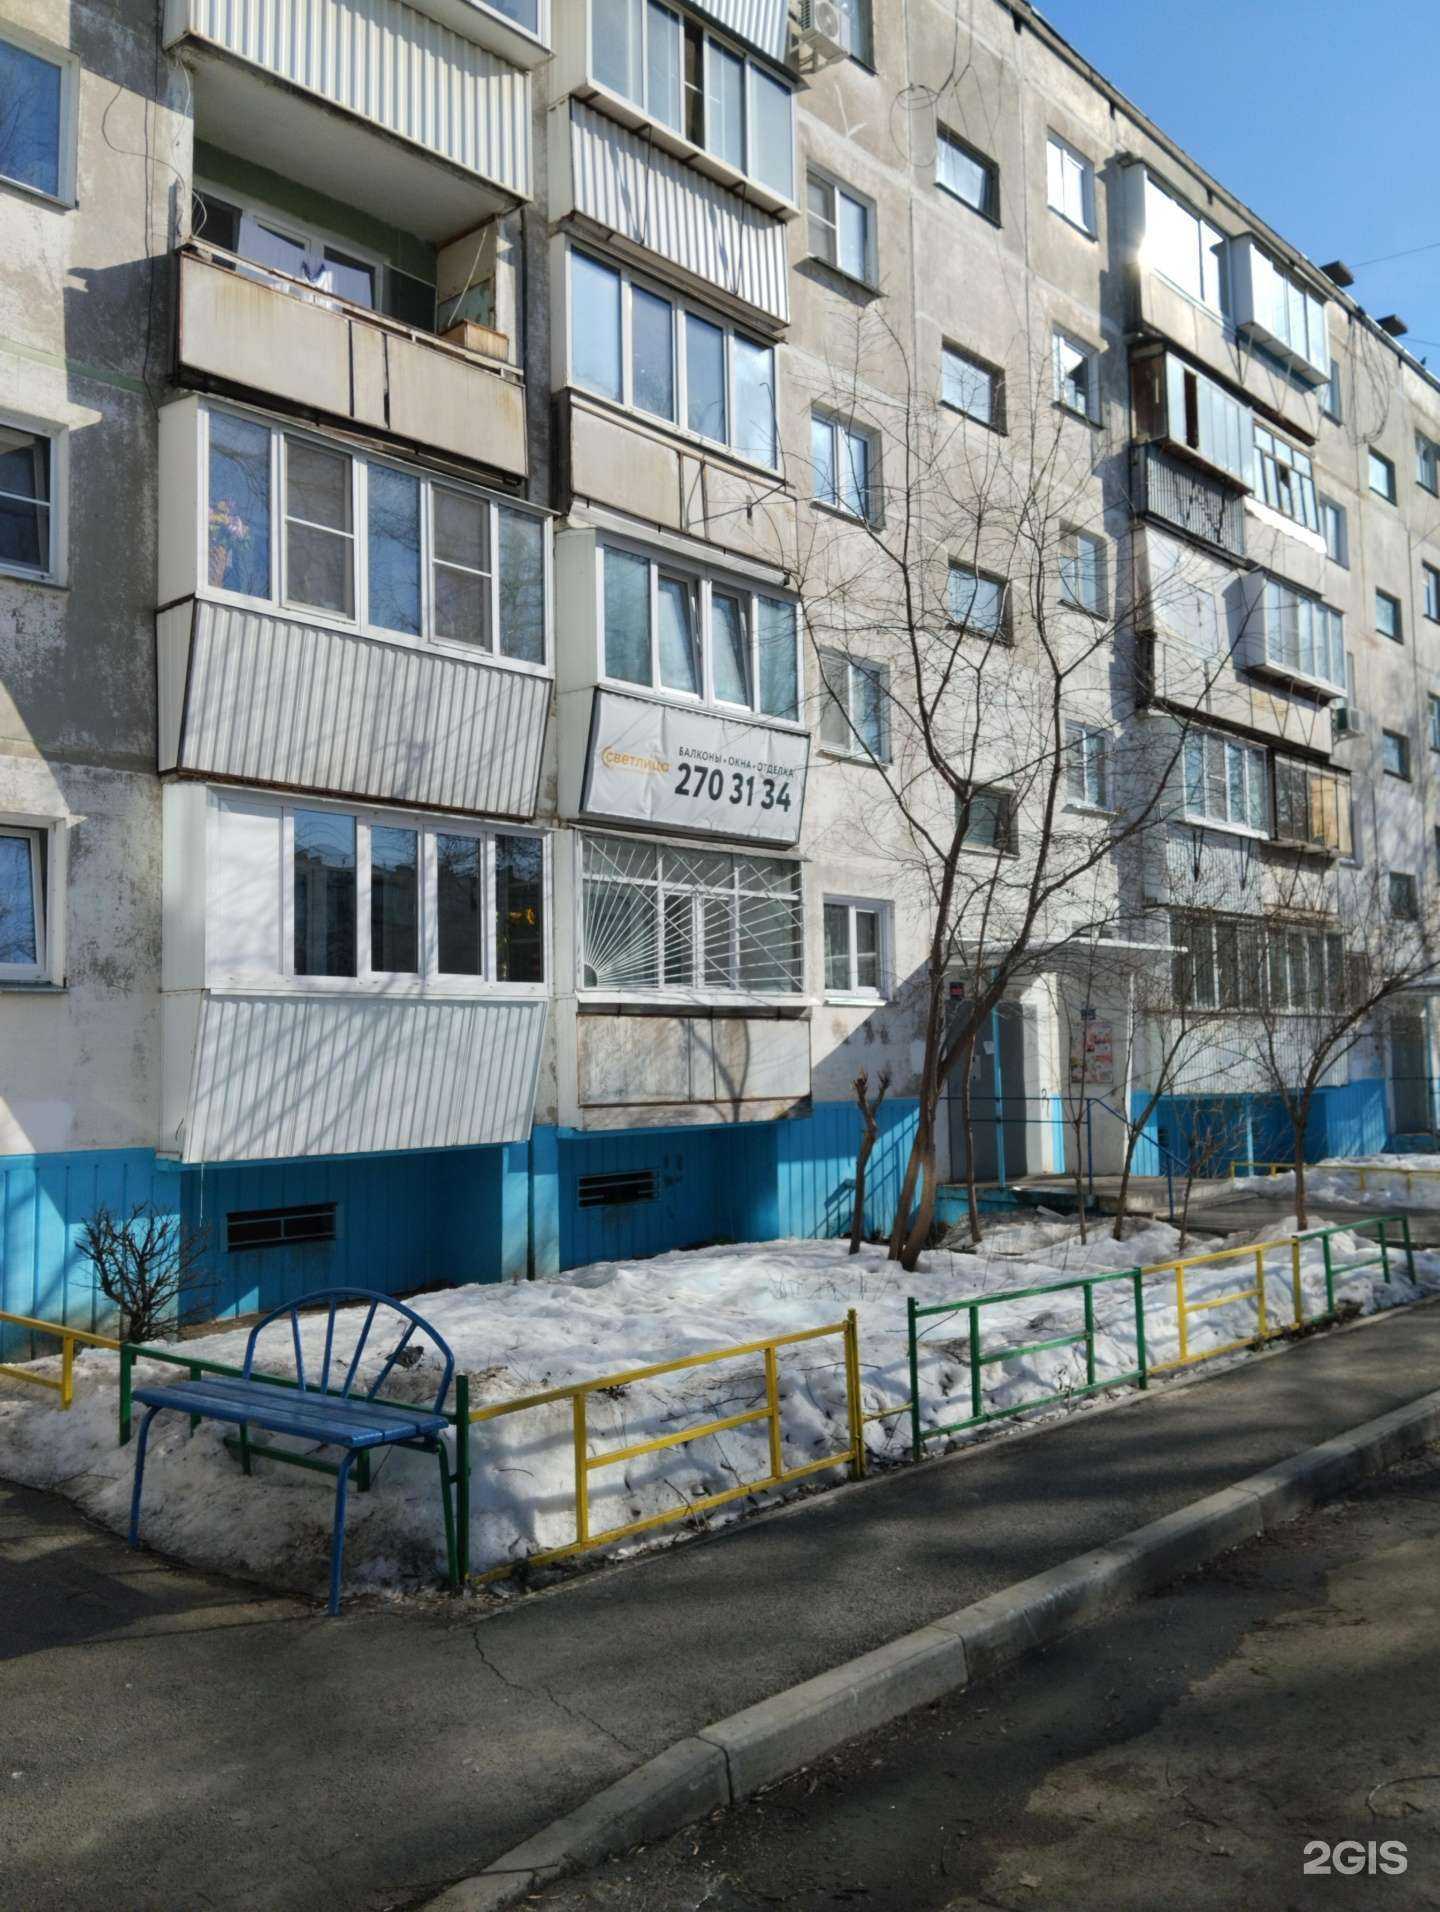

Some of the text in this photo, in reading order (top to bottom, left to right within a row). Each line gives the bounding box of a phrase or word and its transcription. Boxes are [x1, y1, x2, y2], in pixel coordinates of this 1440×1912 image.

[678, 747, 794, 778] БАЛКОНЫ ОКНА ОТДЕЛКА
[674, 763, 791, 812] 270 31 34
